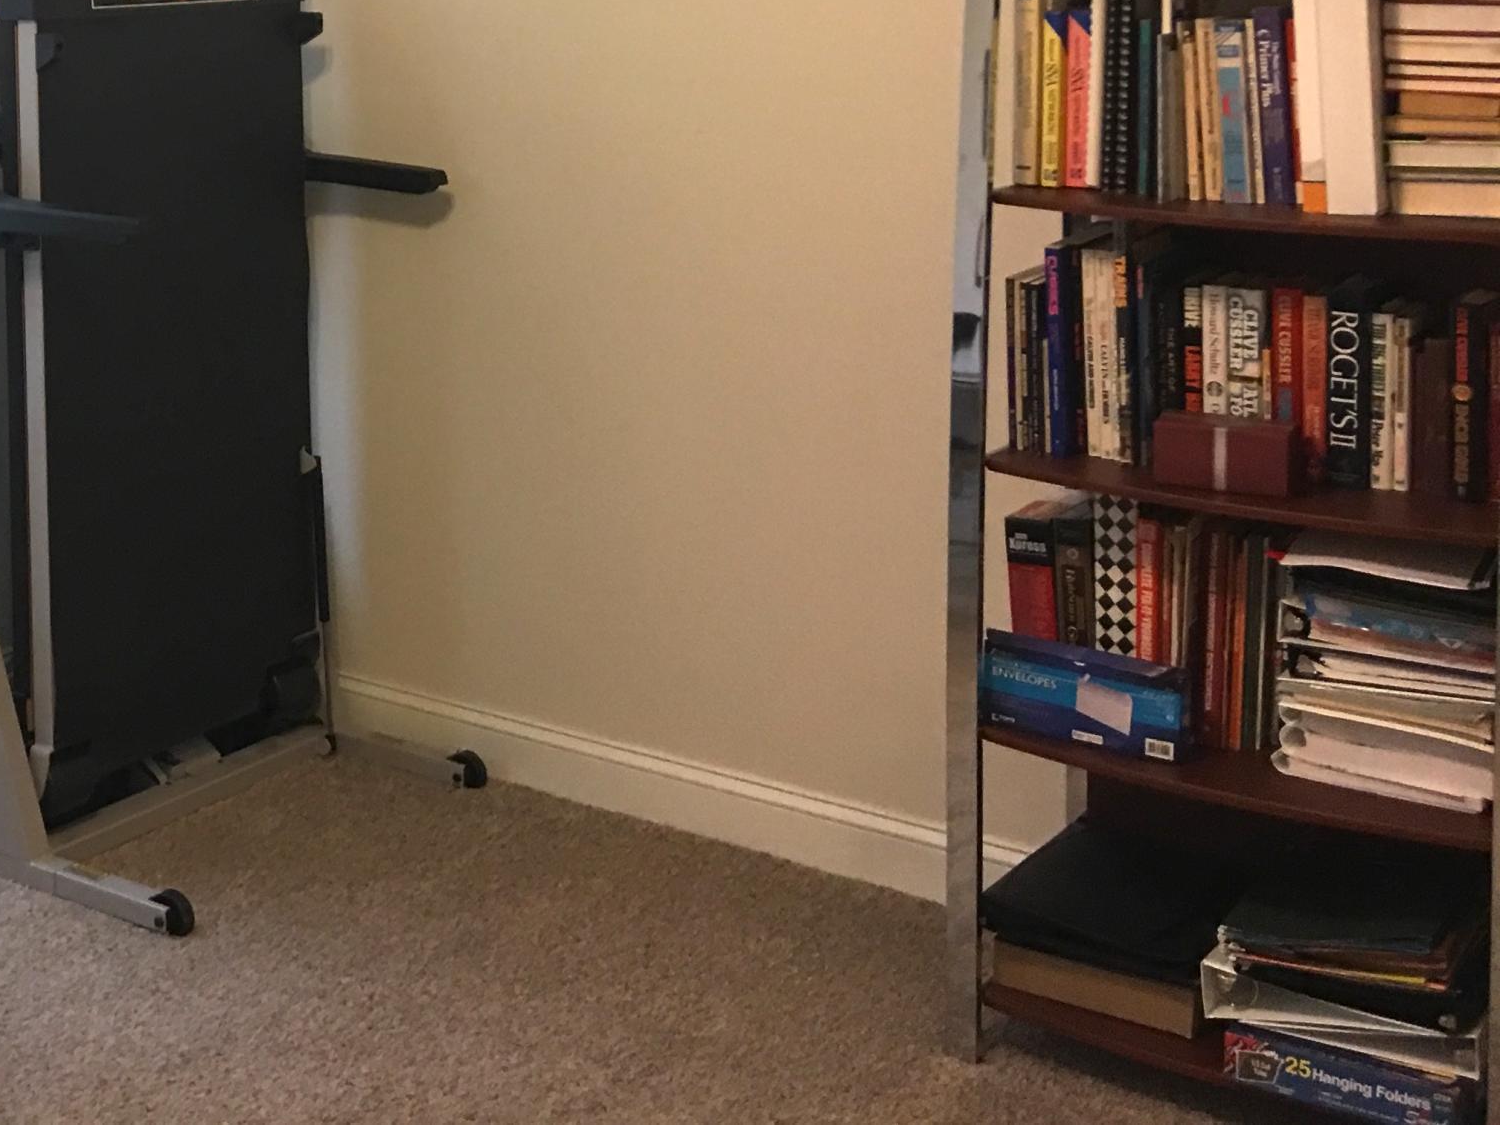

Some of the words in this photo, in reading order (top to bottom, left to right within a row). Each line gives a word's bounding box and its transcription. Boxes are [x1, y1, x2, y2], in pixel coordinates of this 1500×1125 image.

[1259, 41, 1272, 80] Primer
[1261, 83, 1275, 107] Plus
[1209, 293, 1222, 334] Howard
[1278, 295, 1292, 327] CLIVE
[1229, 296, 1244, 370] CUSSLER
[1243, 309, 1260, 359] CLIVE
[1209, 337, 1222, 375] Schultz
[1278, 330, 1292, 384] CUSSLER
[1330, 310, 1360, 429] ROGET'S
[992, 666, 1057, 689] ENVELOPES
[1285, 1056, 1311, 1078] 25
[1312, 1068, 1372, 1098] Hanging
[1376, 1084, 1431, 1111] Folders
